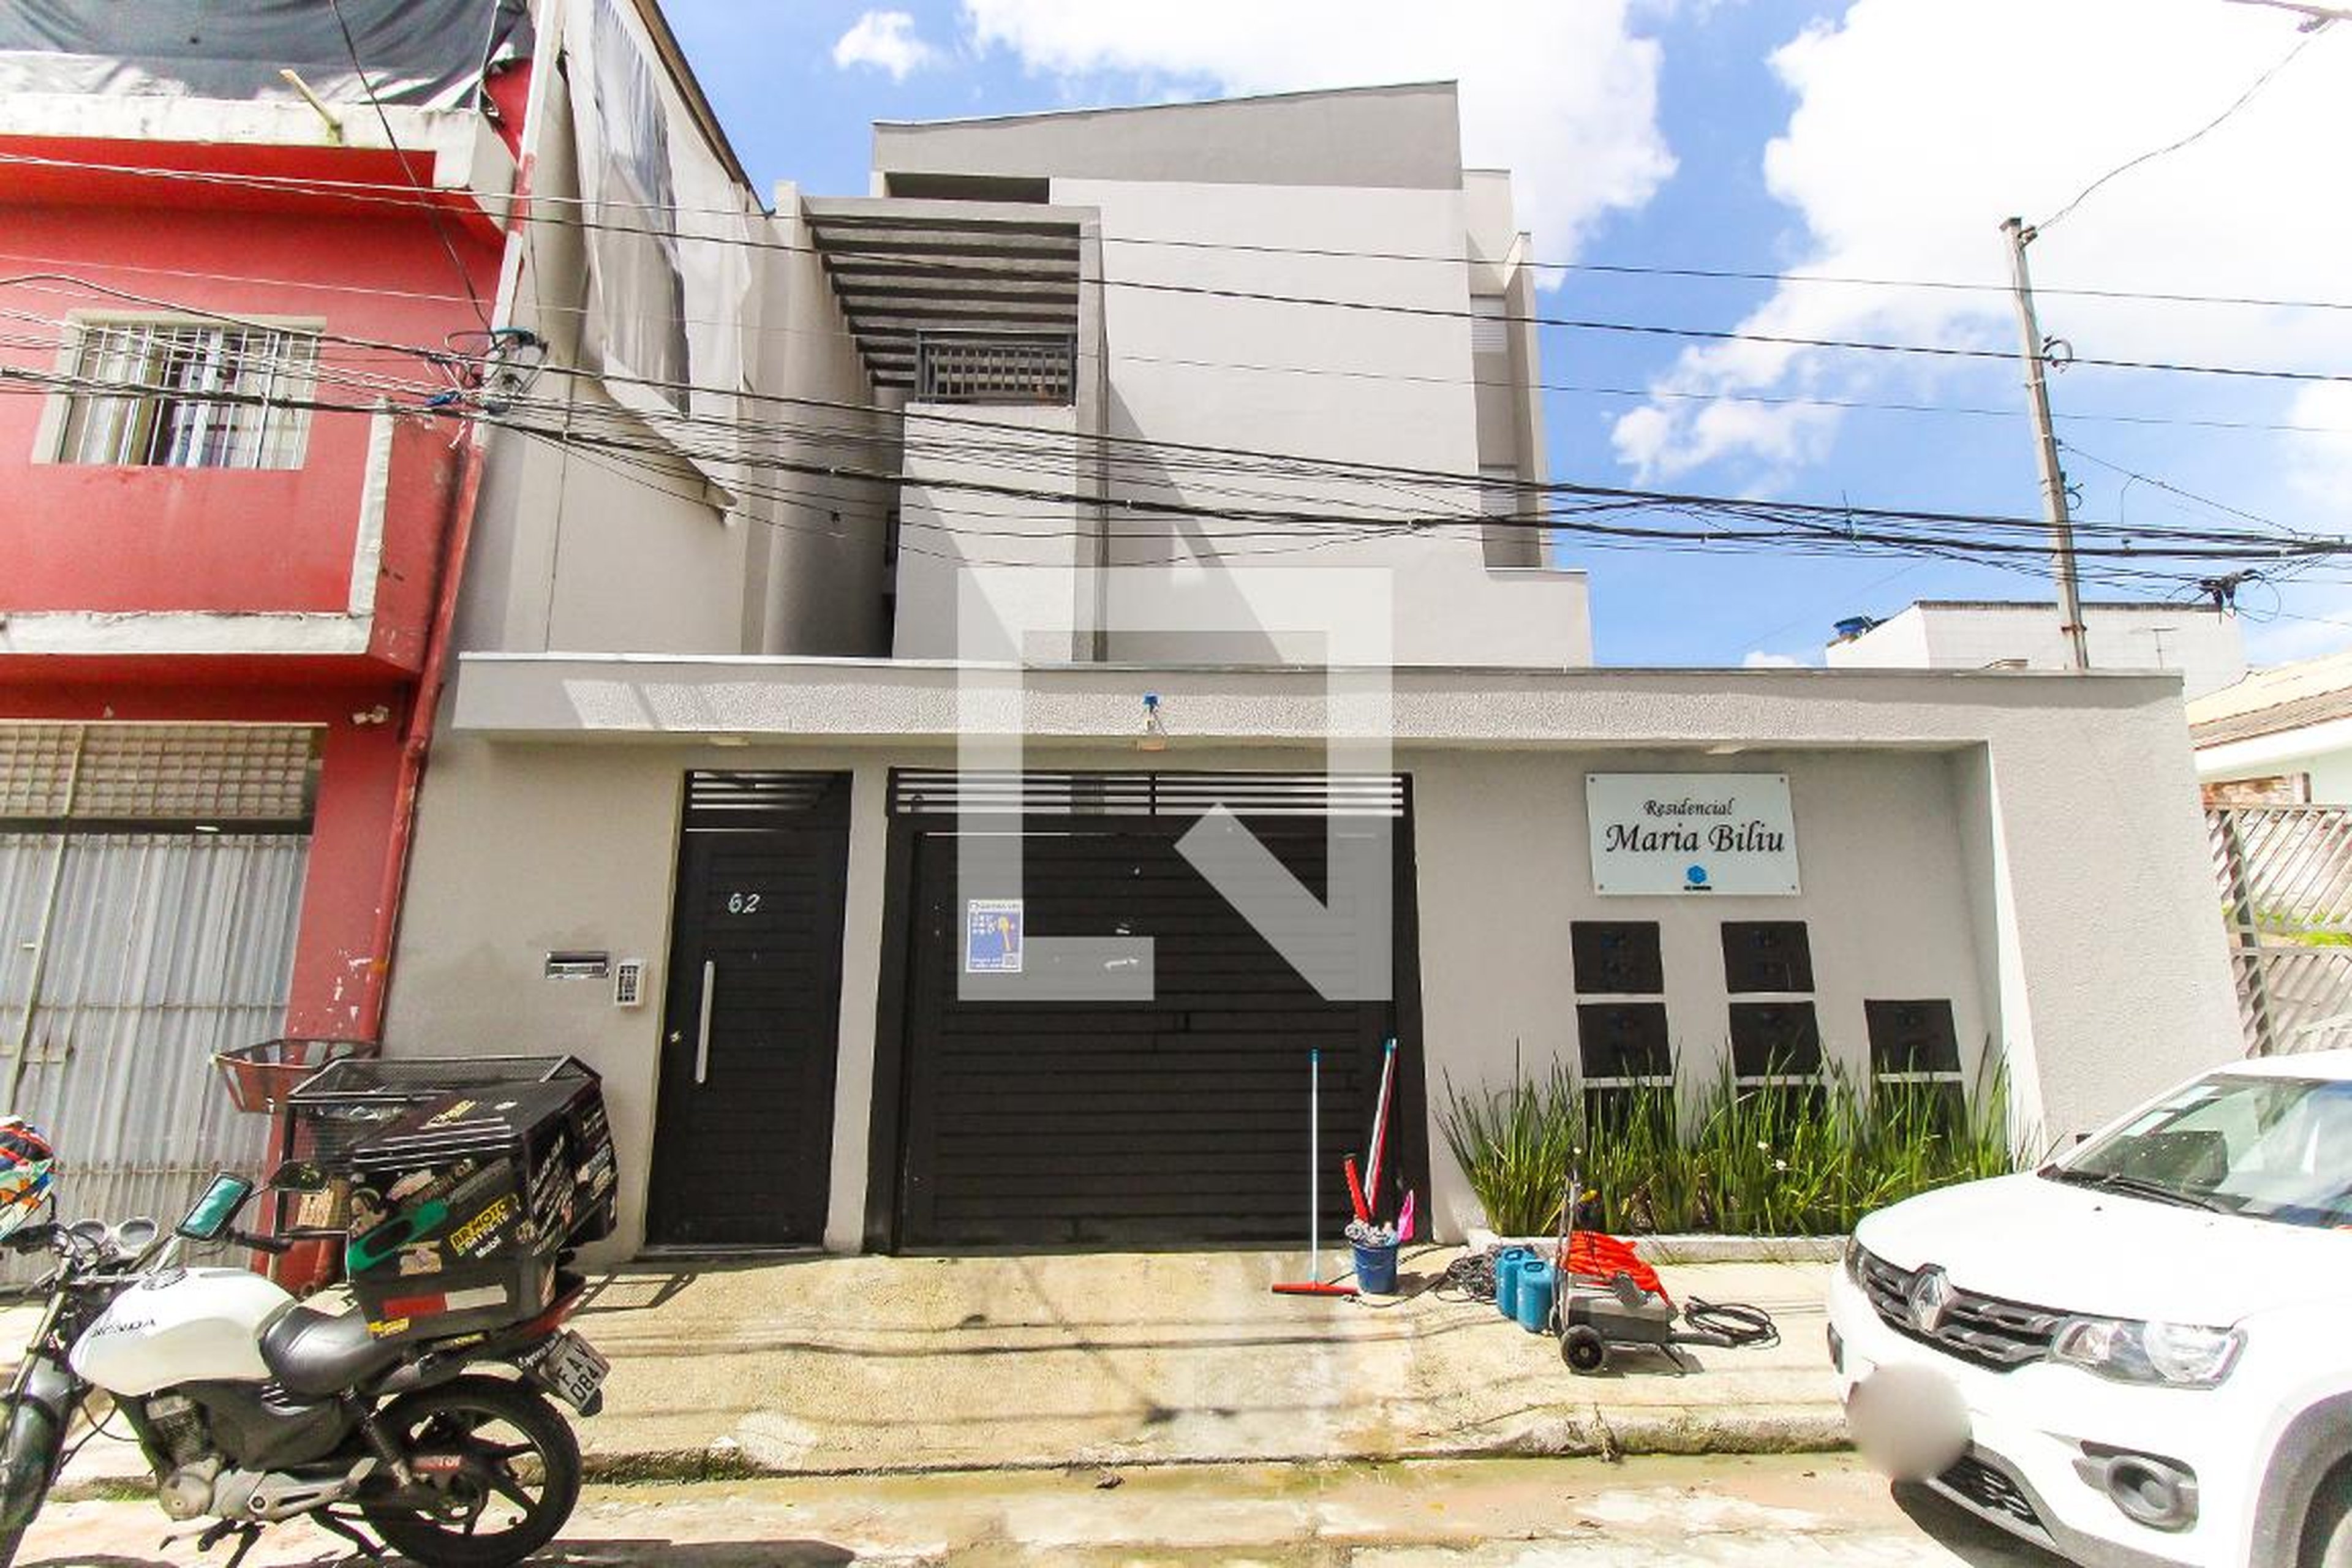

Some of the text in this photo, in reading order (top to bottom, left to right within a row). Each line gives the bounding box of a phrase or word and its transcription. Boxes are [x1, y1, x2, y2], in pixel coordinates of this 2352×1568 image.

[1644, 797, 1735, 817] Residencial
[1606, 820, 1785, 852] Maria Biliu
[728, 893, 760, 914] 62
